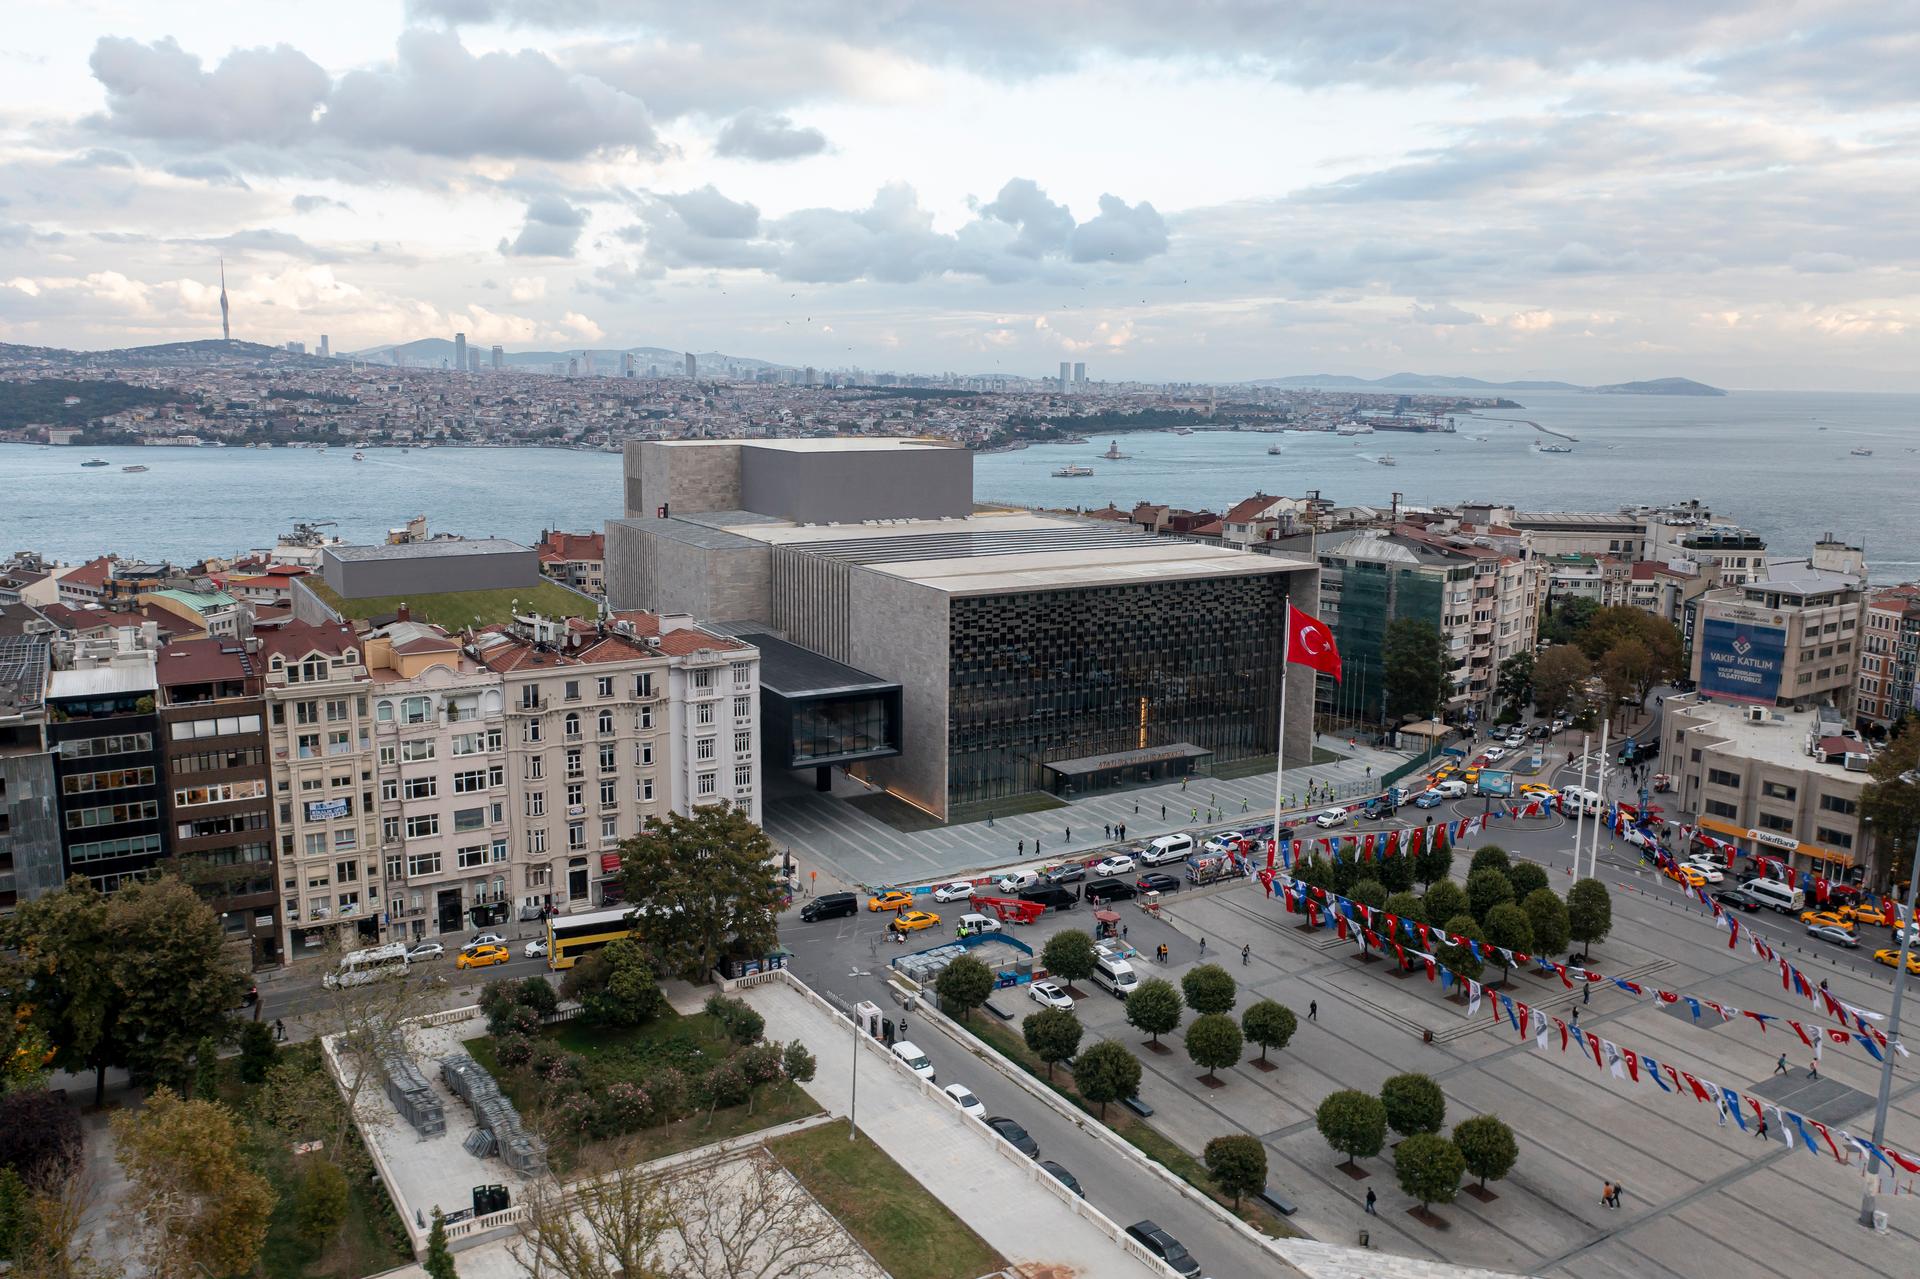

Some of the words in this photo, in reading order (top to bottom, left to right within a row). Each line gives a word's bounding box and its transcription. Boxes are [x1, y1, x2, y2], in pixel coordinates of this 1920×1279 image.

[1710, 652, 1735, 663] VAKIF
[1737, 656, 1773, 670] KATILIM
[1717, 671, 1762, 684] YAŞATIYORUZ
